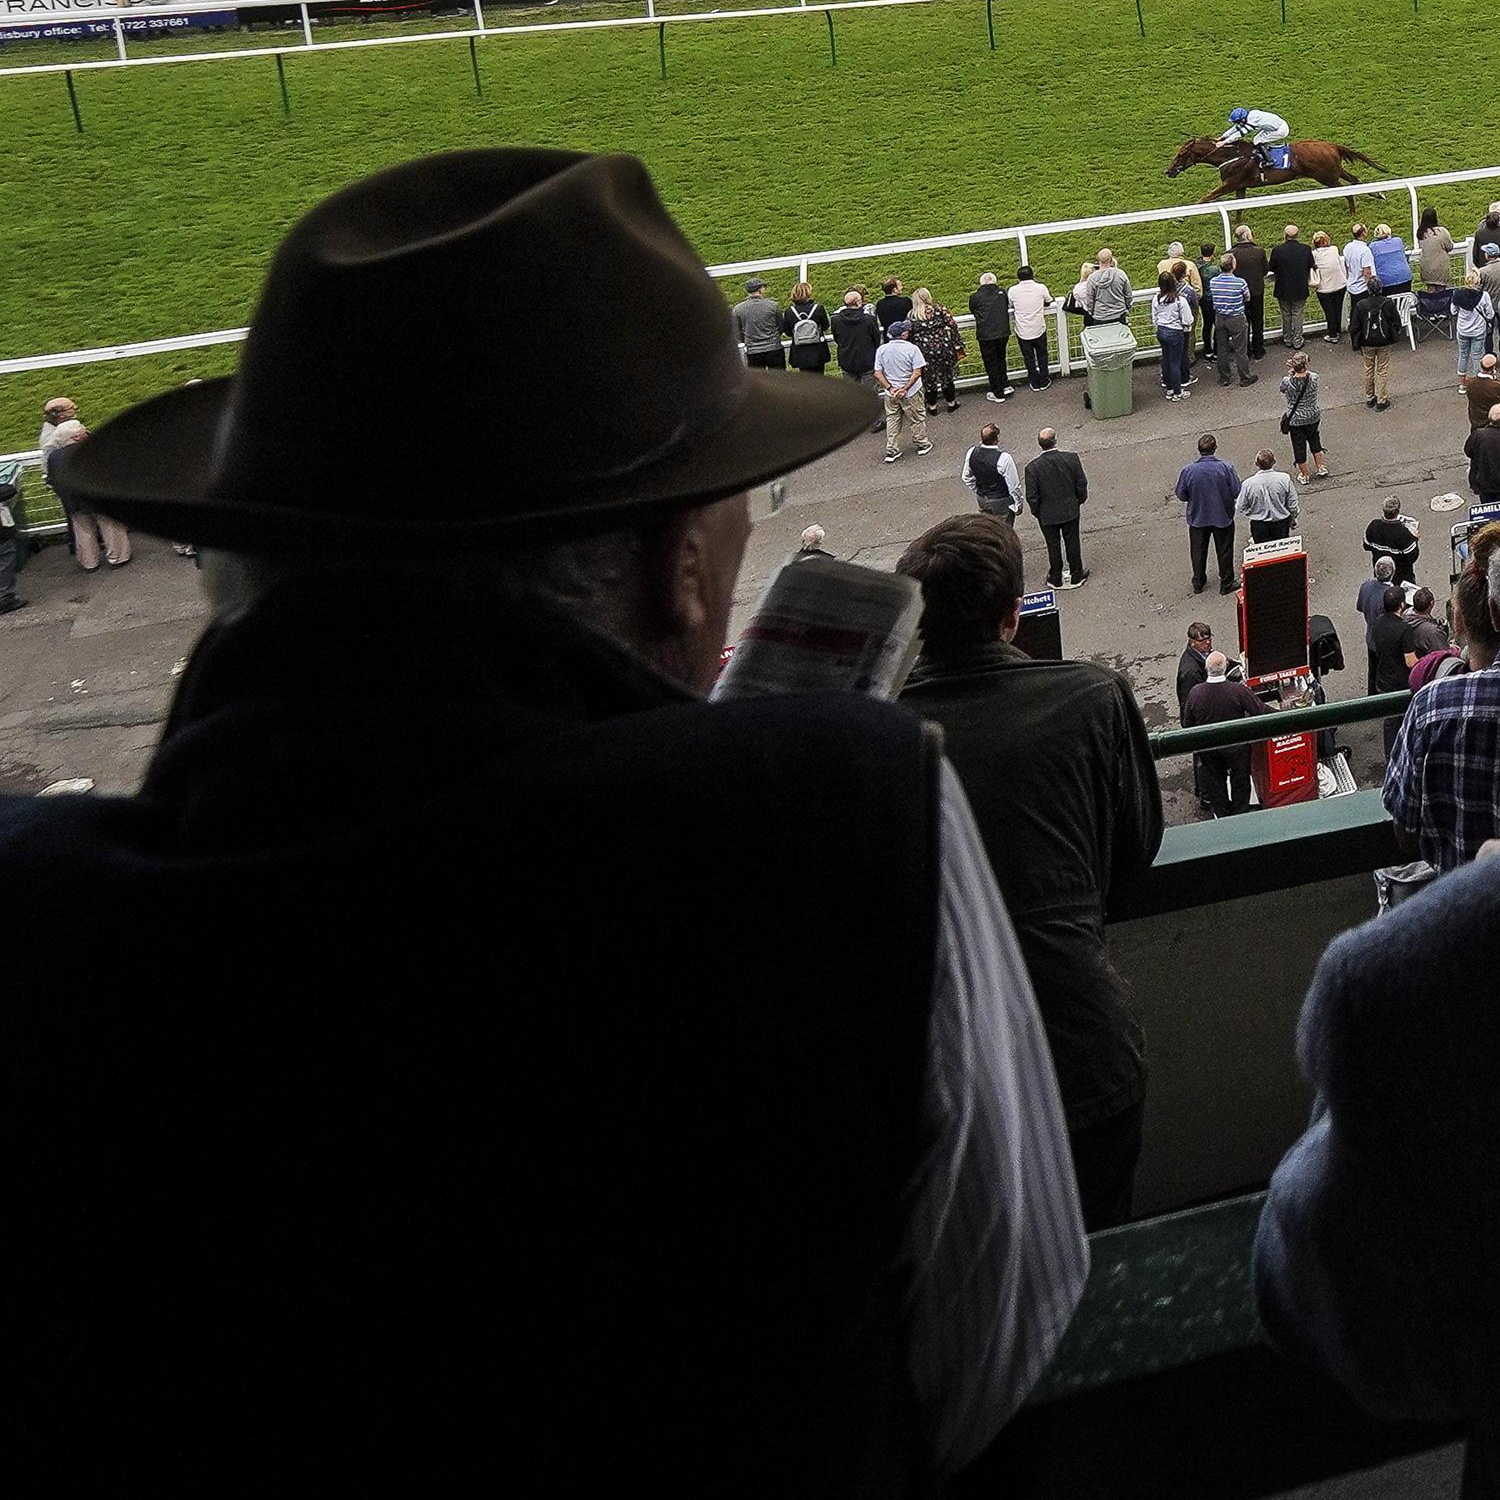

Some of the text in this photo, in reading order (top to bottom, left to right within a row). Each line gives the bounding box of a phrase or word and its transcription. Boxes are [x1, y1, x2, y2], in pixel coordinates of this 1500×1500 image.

[44, 25, 82, 37] office:
[88, 23, 109, 33] Tel:
[1282, 153, 1290, 169] 1
[1278, 538, 1301, 548] Racing
[1276, 736, 1303, 748] RACING
